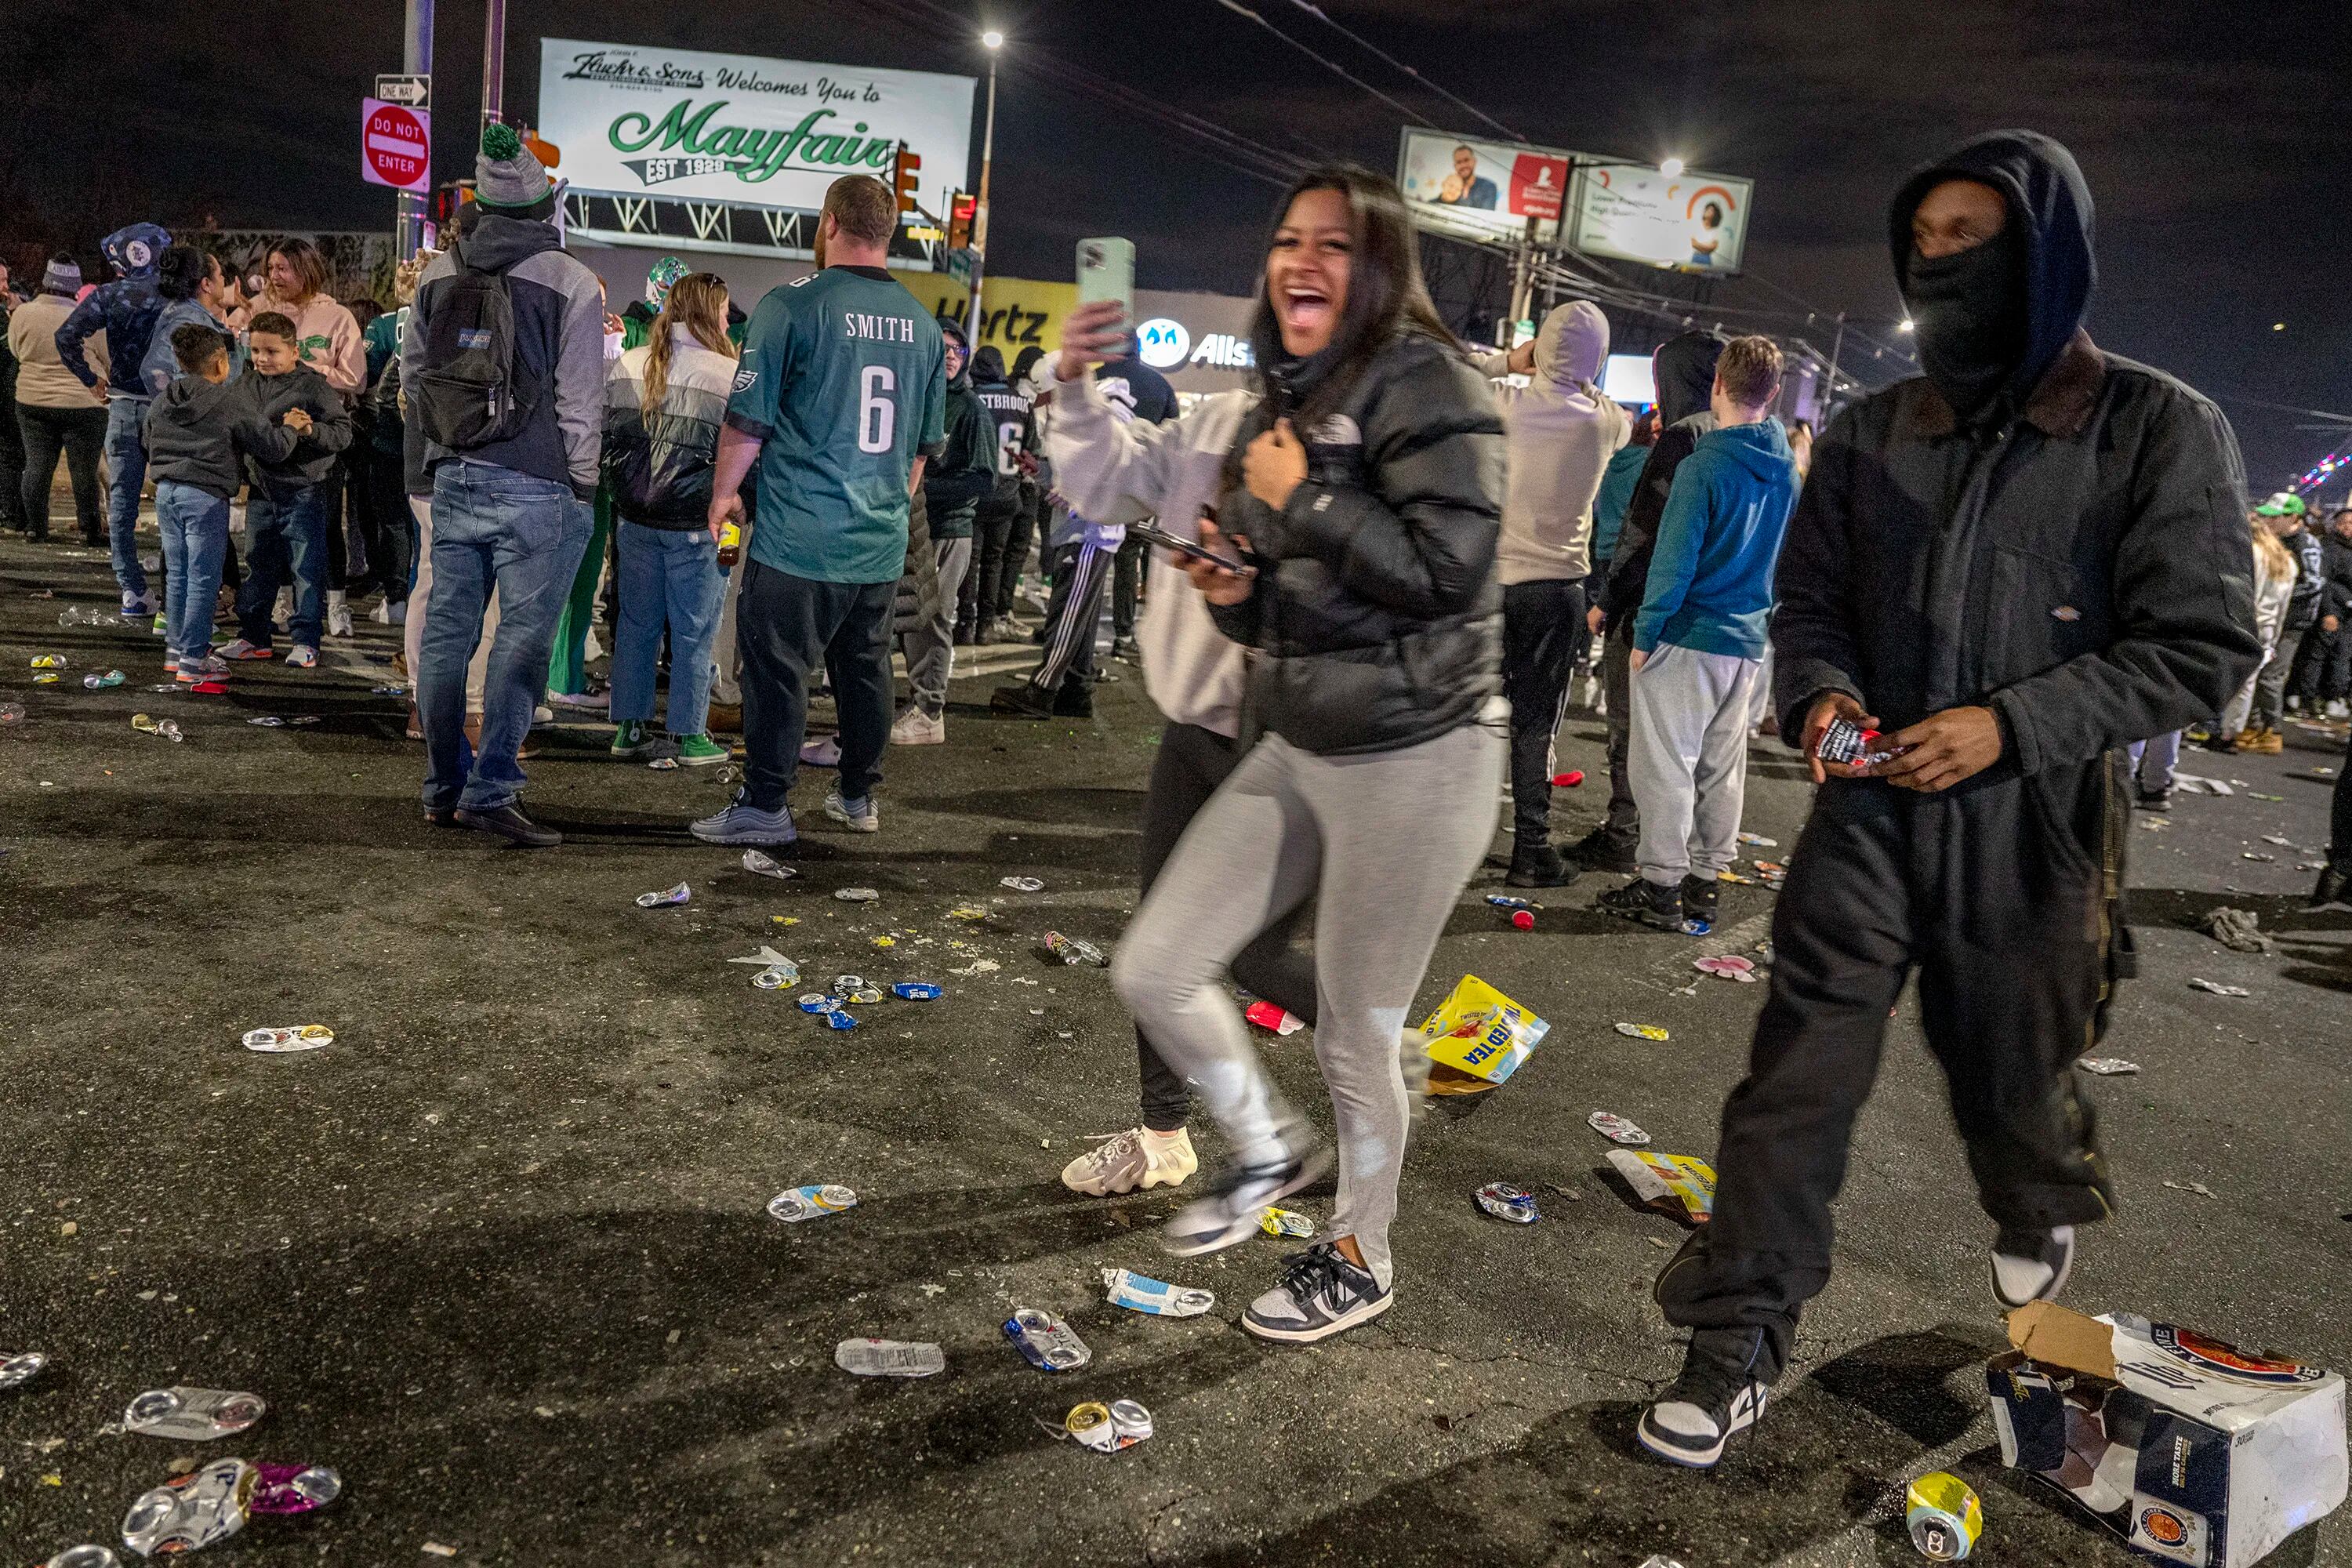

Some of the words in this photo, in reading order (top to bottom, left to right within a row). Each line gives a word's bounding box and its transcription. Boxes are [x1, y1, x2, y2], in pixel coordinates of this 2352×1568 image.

[637, 65, 650, 77] &
[655, 61, 703, 88] Sons
[717, 67, 808, 96] Welcomes
[816, 76, 855, 103] You
[863, 82, 880, 103] to
[382, 85, 396, 97] ONE
[399, 86, 413, 97] WAY
[375, 118, 390, 132] DO
[396, 122, 419, 140] NOT
[608, 99, 894, 183] Mayfair
[379, 154, 415, 173] ENTER
[645, 159, 679, 183] EST
[845, 312, 914, 343] SMITH
[858, 365, 895, 453] 6
[978, 393, 1029, 413] STBROOK
[1486, 1004, 1522, 1047] TWSTED
[1462, 1043, 1497, 1065] TEA
[2156, 1328, 2185, 1356] FINE
[2174, 1436, 2183, 1461] TASTE
[2235, 1435, 2245, 1448] 30
[2172, 1461, 2180, 1486] MORE
